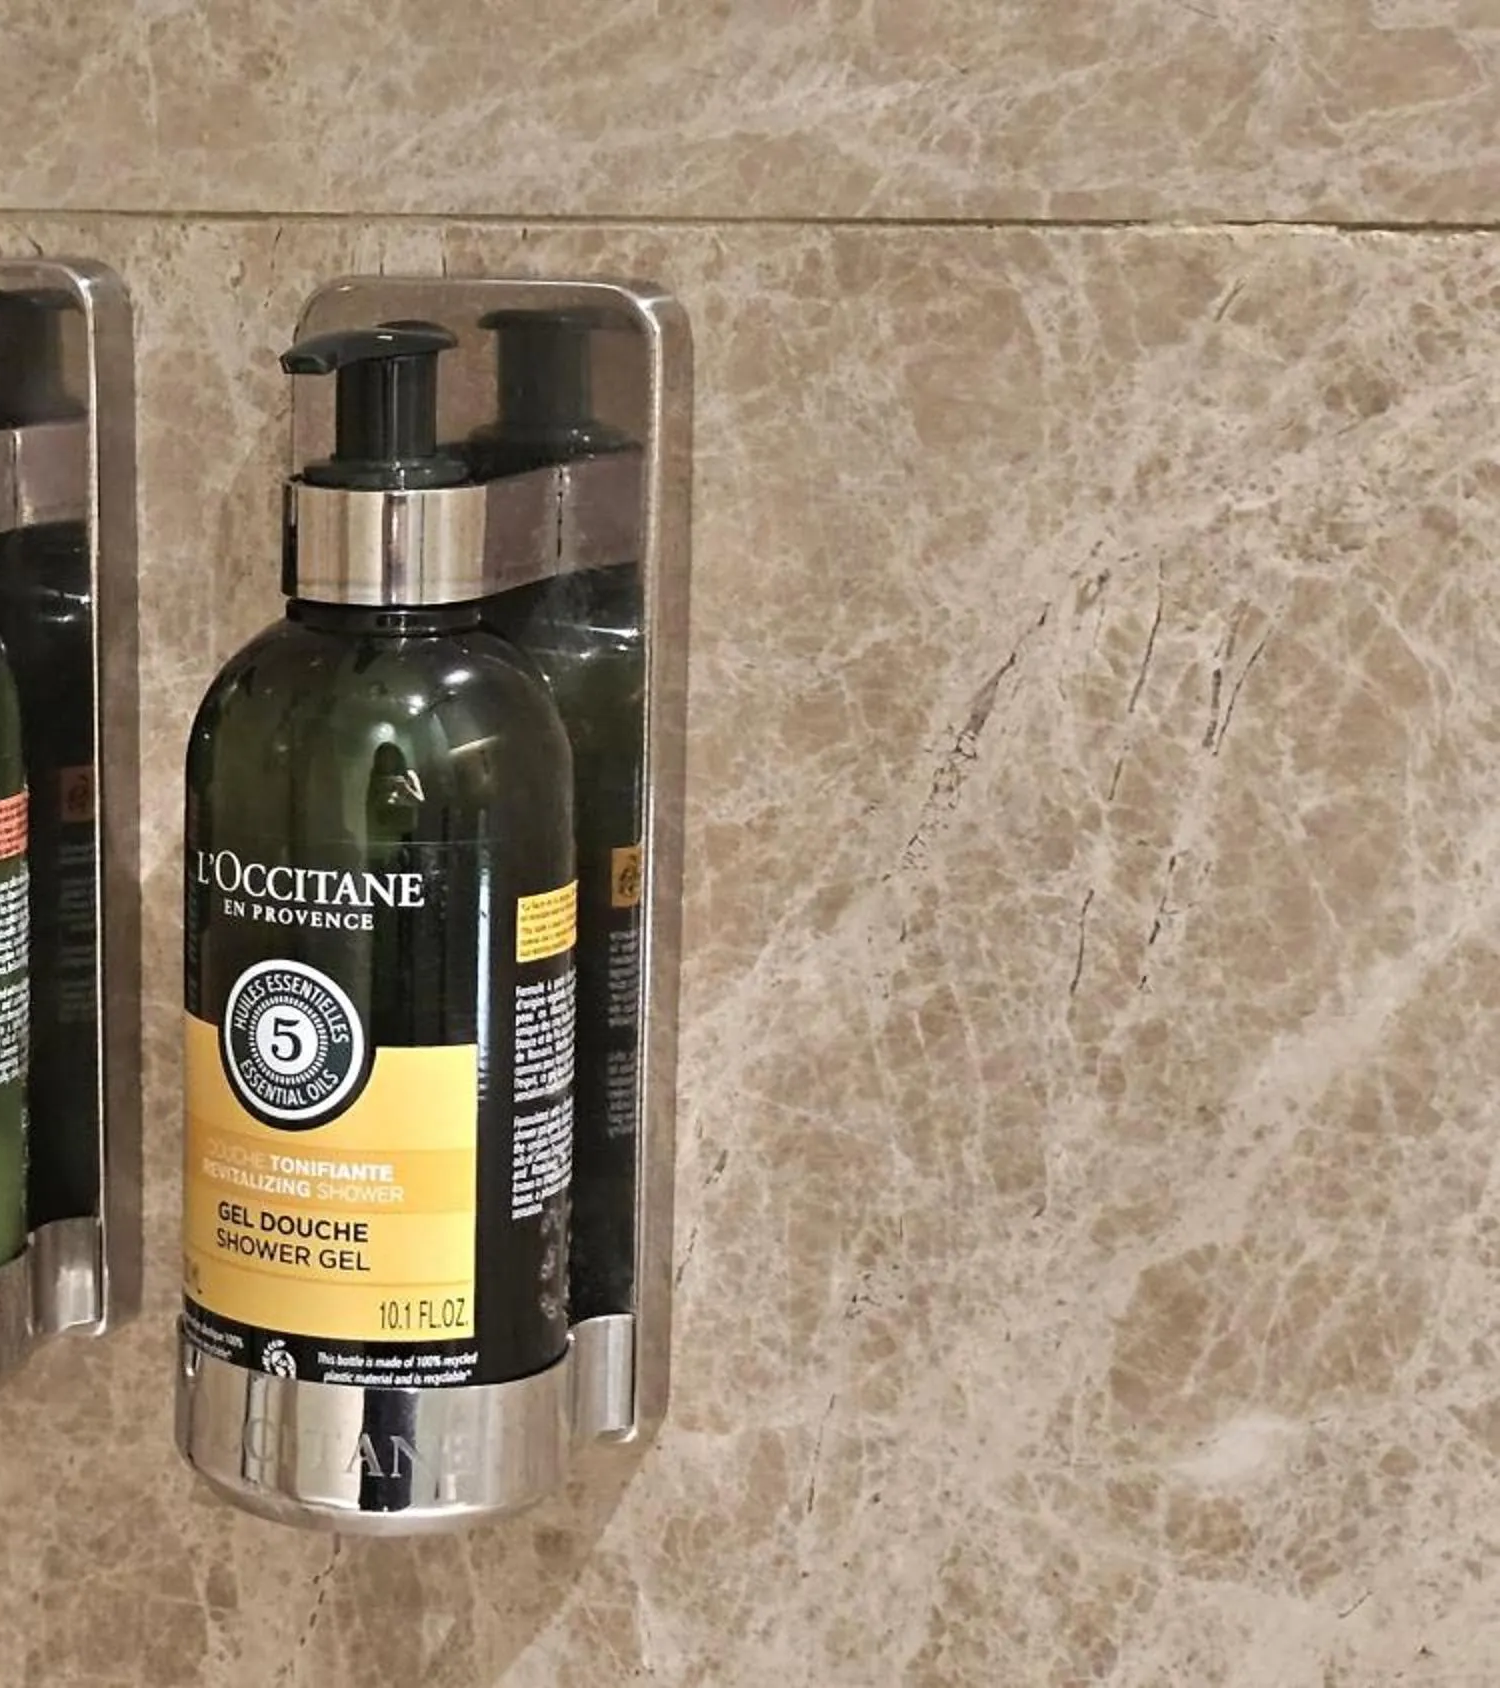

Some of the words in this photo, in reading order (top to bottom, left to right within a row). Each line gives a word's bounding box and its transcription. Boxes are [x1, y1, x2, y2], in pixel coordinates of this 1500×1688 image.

[197, 850, 425, 907] L'OCCITANE
[224, 899, 245, 917] EN
[252, 907, 374, 930] PROVENCE
[234, 979, 265, 1030] HUILES
[265, 974, 349, 1043] ESSENTIELLES
[271, 1017, 302, 1062] 5
[239, 1059, 307, 1105] ESSENTIAL
[306, 1069, 338, 1100] OILS
[203, 1158, 311, 1198] REVITALIZING
[316, 1183, 405, 1203] SHOWER
[269, 1154, 394, 1183] TONIFIANTE
[218, 1200, 254, 1229] GEL
[260, 1211, 368, 1243] DOUCHE
[217, 1228, 311, 1267] SHOWER
[319, 1249, 370, 1271] GEL
[380, 1301, 411, 1329] 10.1
